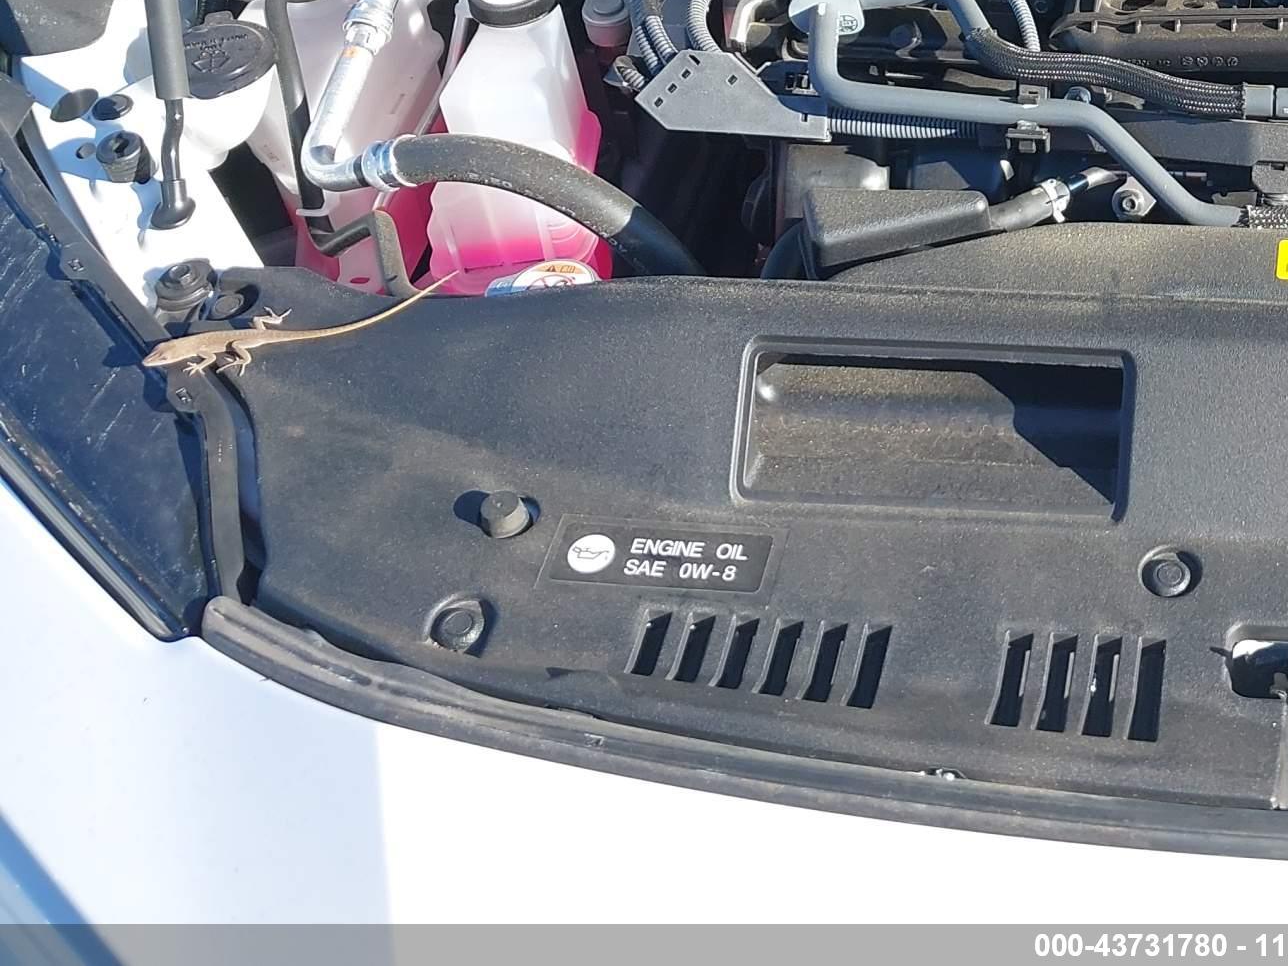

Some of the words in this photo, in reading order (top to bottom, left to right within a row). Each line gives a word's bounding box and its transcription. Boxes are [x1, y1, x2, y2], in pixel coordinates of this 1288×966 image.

[630, 538, 705, 558] ENGINE
[715, 543, 748, 561] OIL
[623, 559, 667, 578] SAE
[679, 563, 737, 582] 0W-8
